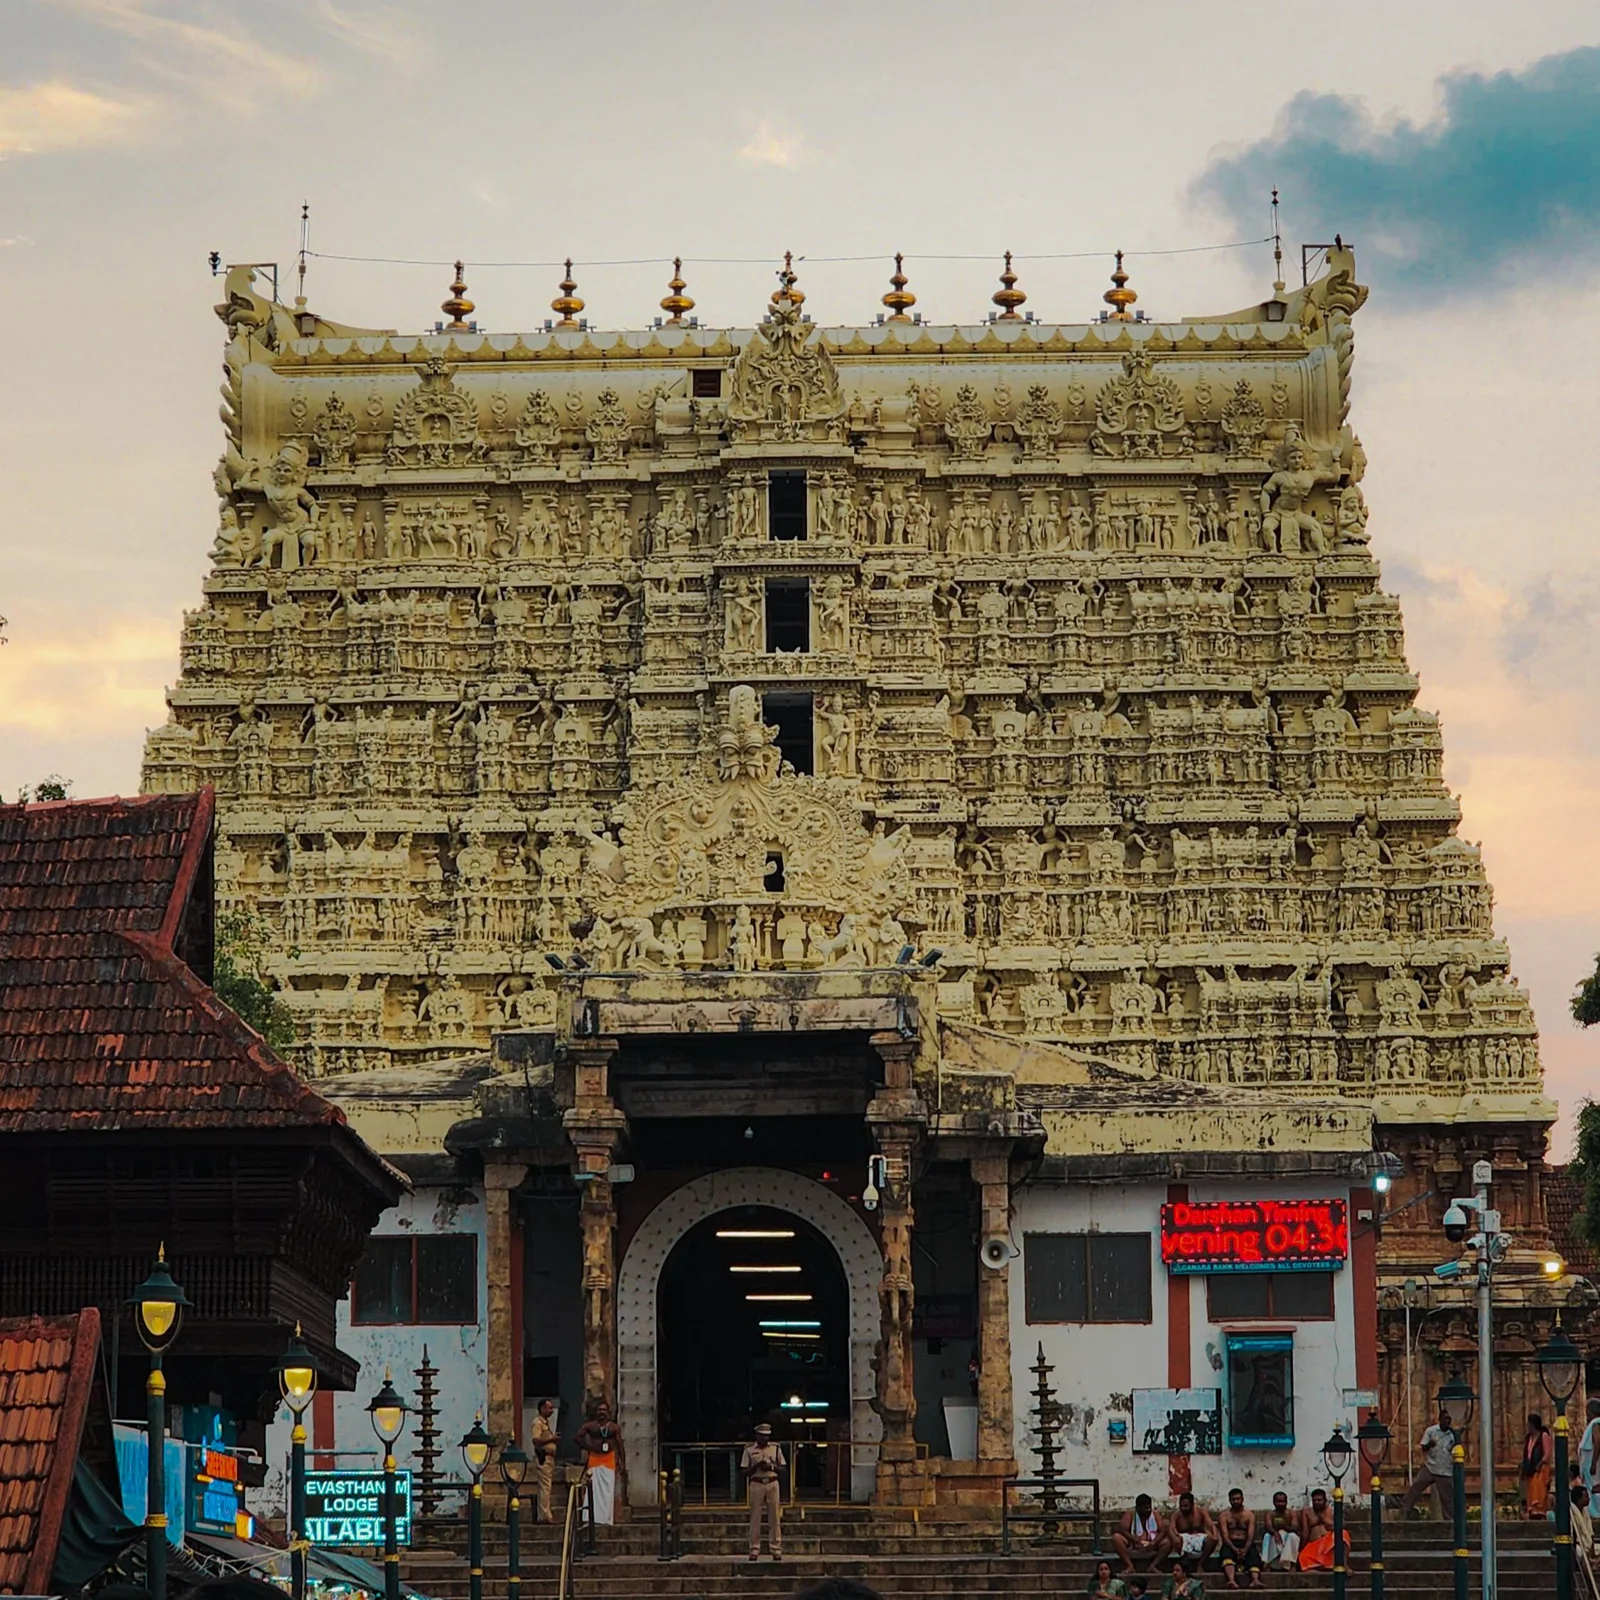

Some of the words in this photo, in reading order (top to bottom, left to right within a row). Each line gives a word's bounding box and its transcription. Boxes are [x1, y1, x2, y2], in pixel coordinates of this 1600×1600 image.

[1174, 1203, 1258, 1225] Darshan
[1259, 1201, 1331, 1226] Timing
[1181, 1263, 1211, 1271] CANARA
[1292, 1261, 1330, 1269] DEVOTEES
[304, 1480, 407, 1495] EVASTHANM
[324, 1498, 378, 1512] LODGE
